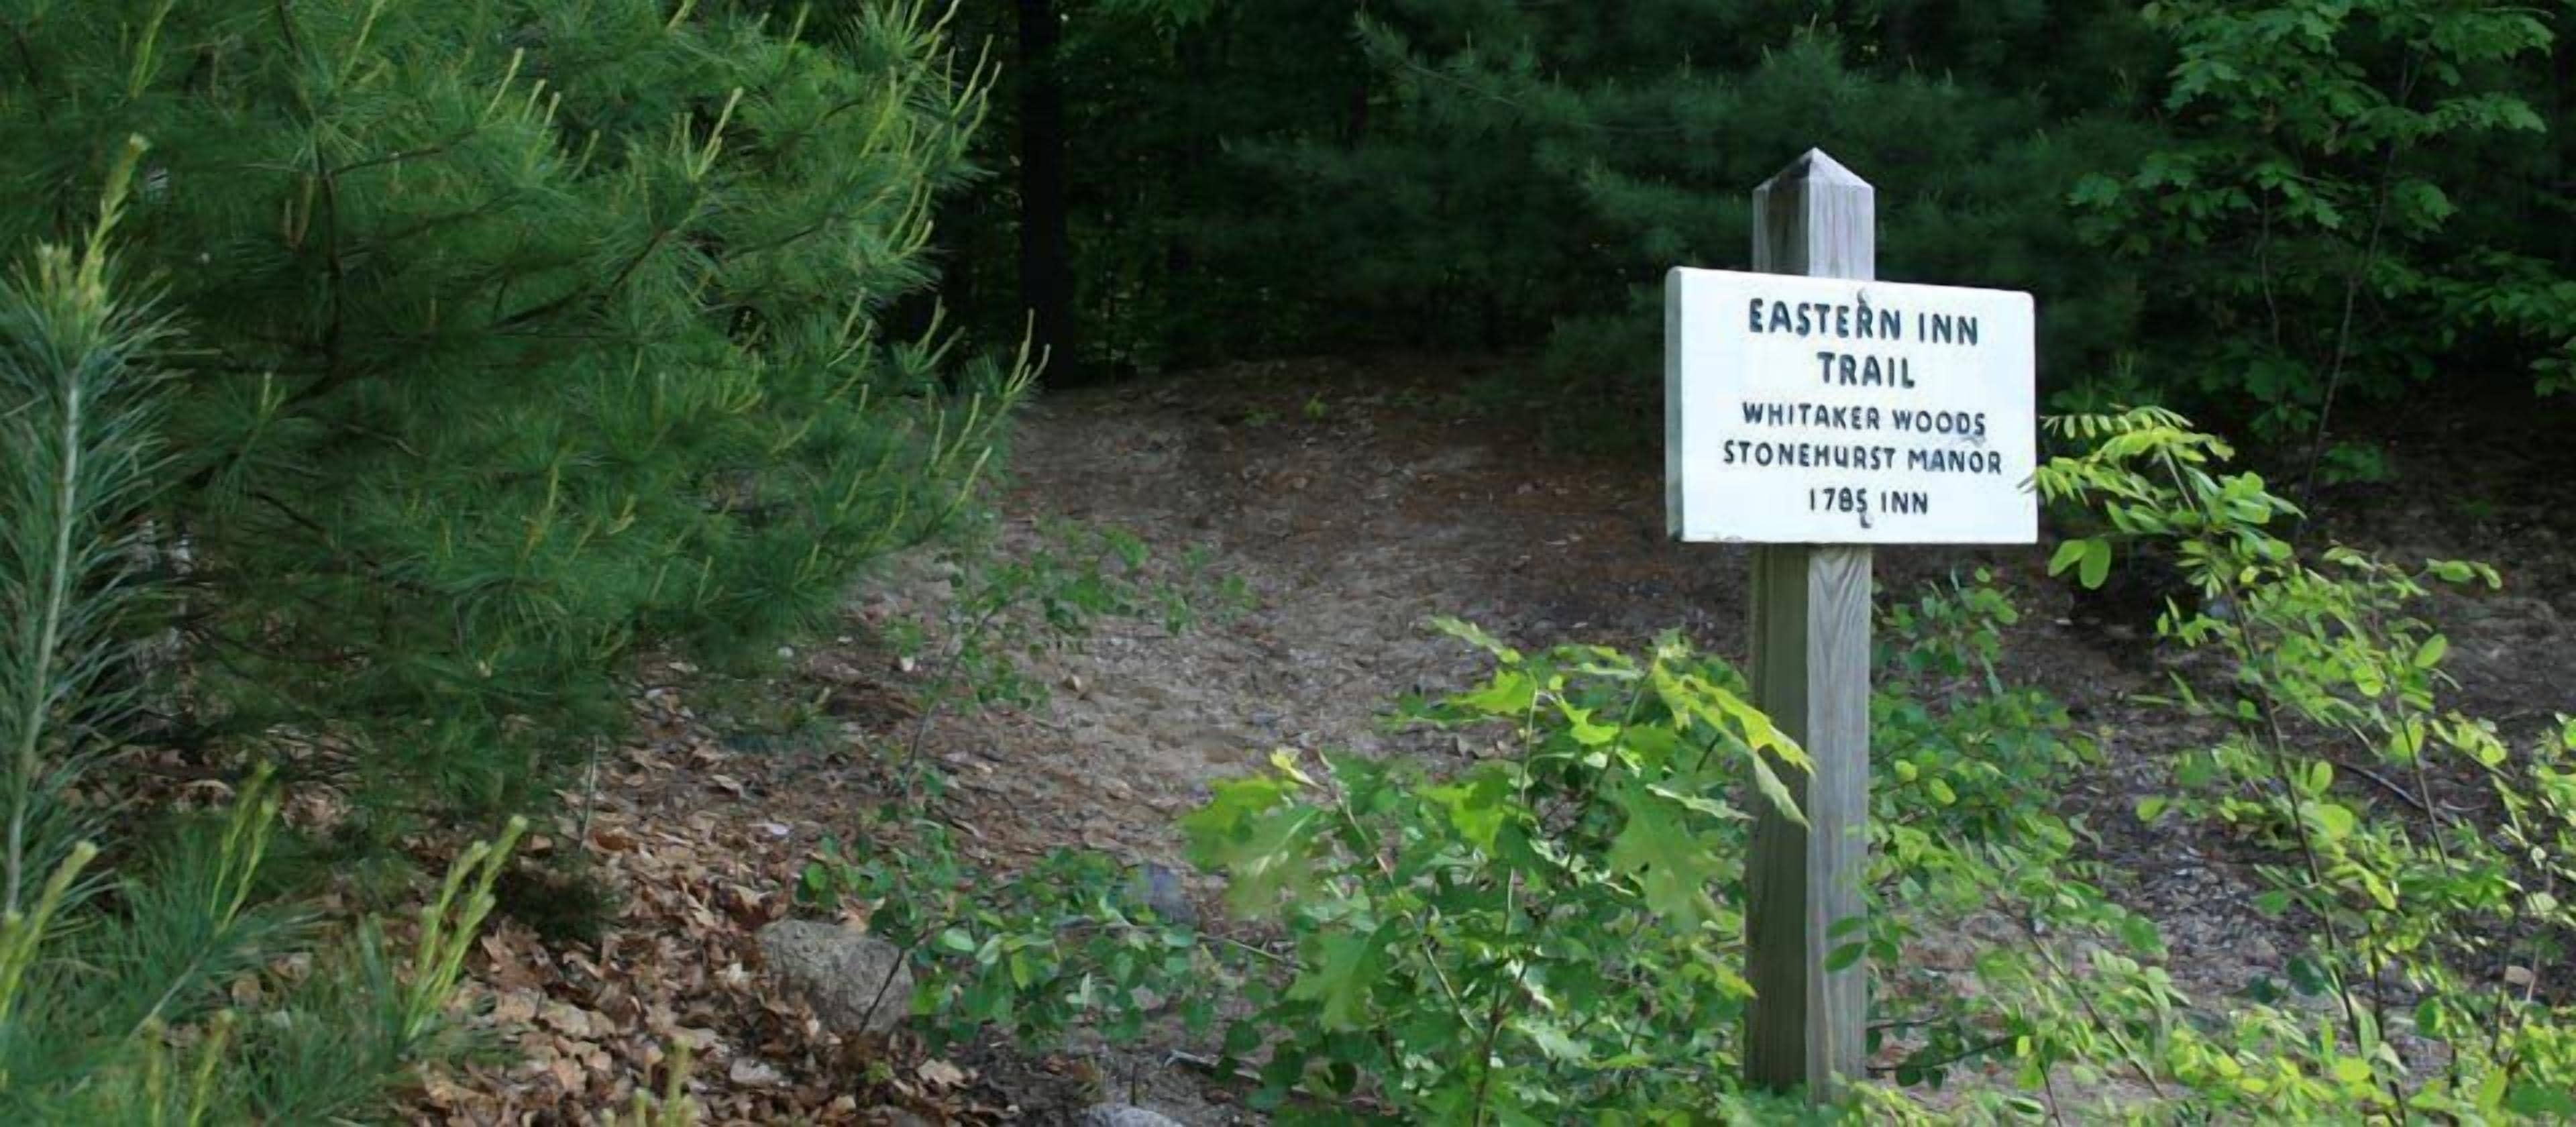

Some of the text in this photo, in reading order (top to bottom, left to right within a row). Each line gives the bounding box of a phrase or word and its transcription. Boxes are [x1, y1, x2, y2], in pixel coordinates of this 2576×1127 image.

[1748, 297, 1978, 345] EASTERN INN
[1816, 351, 1916, 388] TRAIL
[1741, 402, 1986, 436] WHITAKER WOODS
[1723, 439, 2002, 474] STONEHURST MANOR
[1809, 487, 1929, 515] 1785 INN
